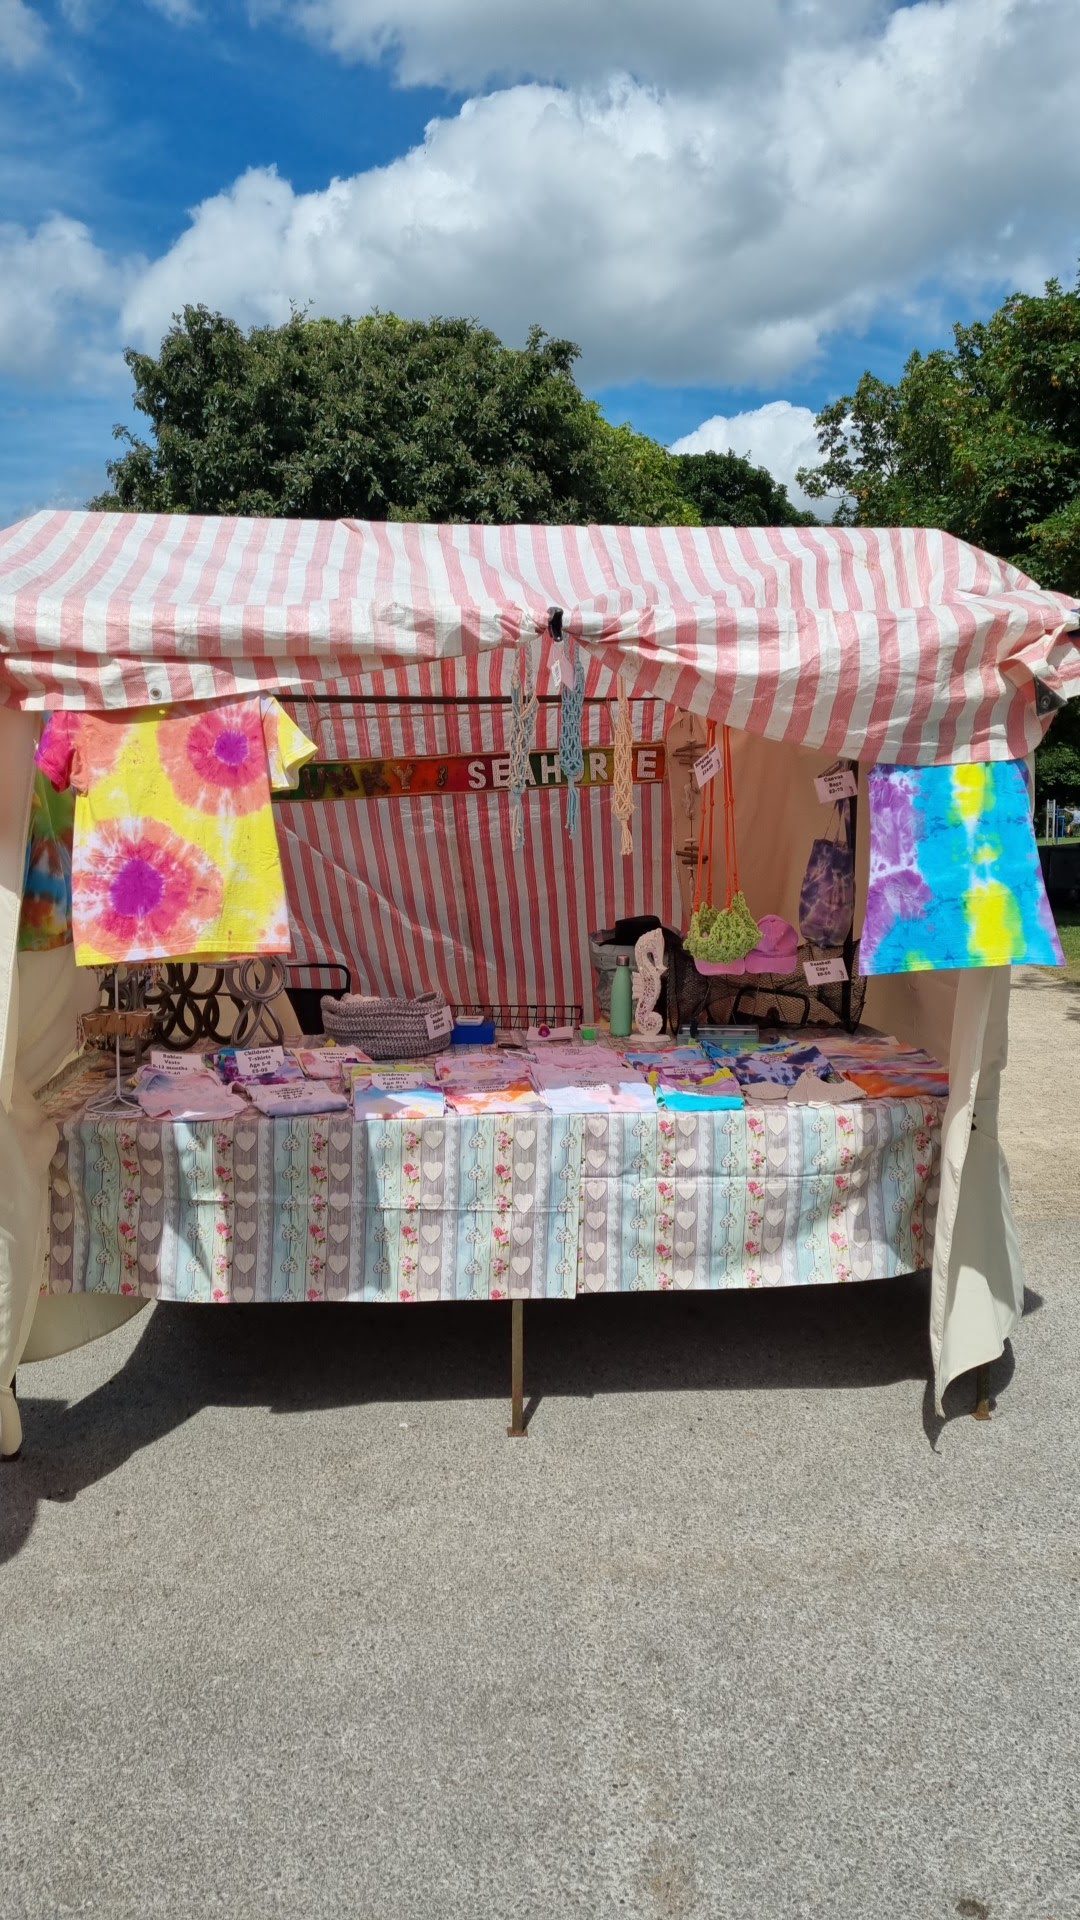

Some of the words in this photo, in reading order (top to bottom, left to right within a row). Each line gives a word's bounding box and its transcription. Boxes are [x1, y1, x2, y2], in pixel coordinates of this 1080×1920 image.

[290, 762, 417, 800] UNKY
[467, 750, 657, 790] SEAHRE
[823, 774, 844, 782] Canvas
